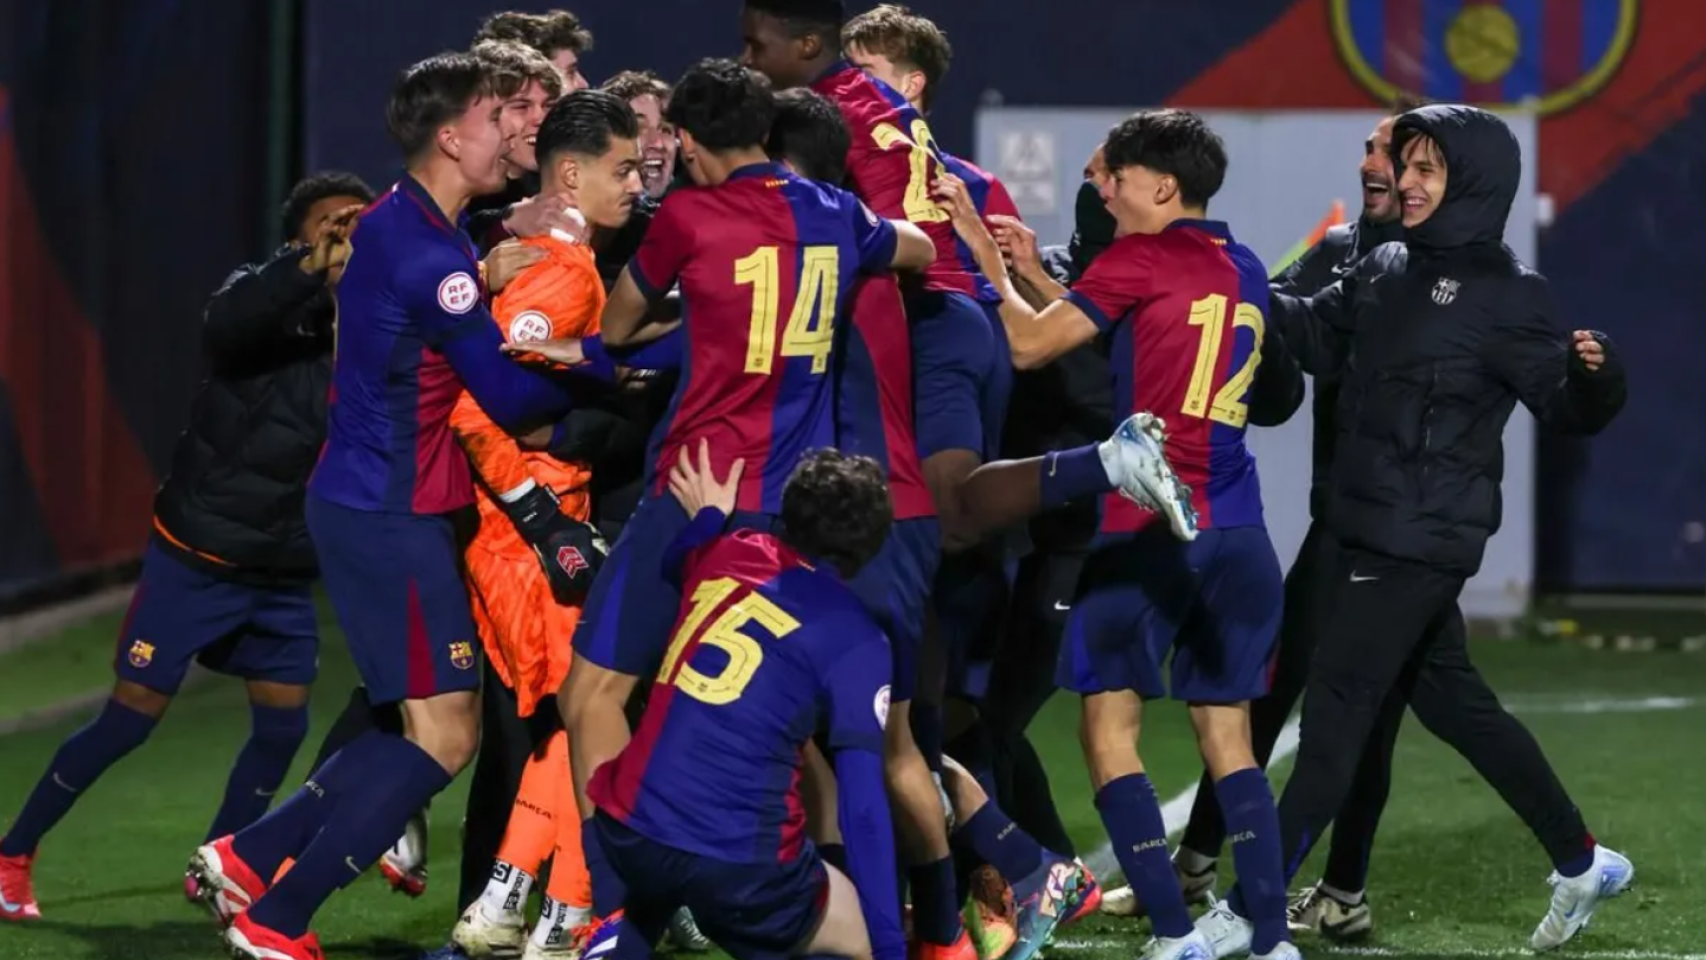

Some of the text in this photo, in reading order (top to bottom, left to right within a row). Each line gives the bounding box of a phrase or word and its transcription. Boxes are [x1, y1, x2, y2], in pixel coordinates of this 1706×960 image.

[448, 282, 468, 294] RF
[449, 293, 470, 305] EF
[735, 246, 838, 375] 14
[1181, 293, 1265, 428] 12
[656, 576, 801, 705] 15
